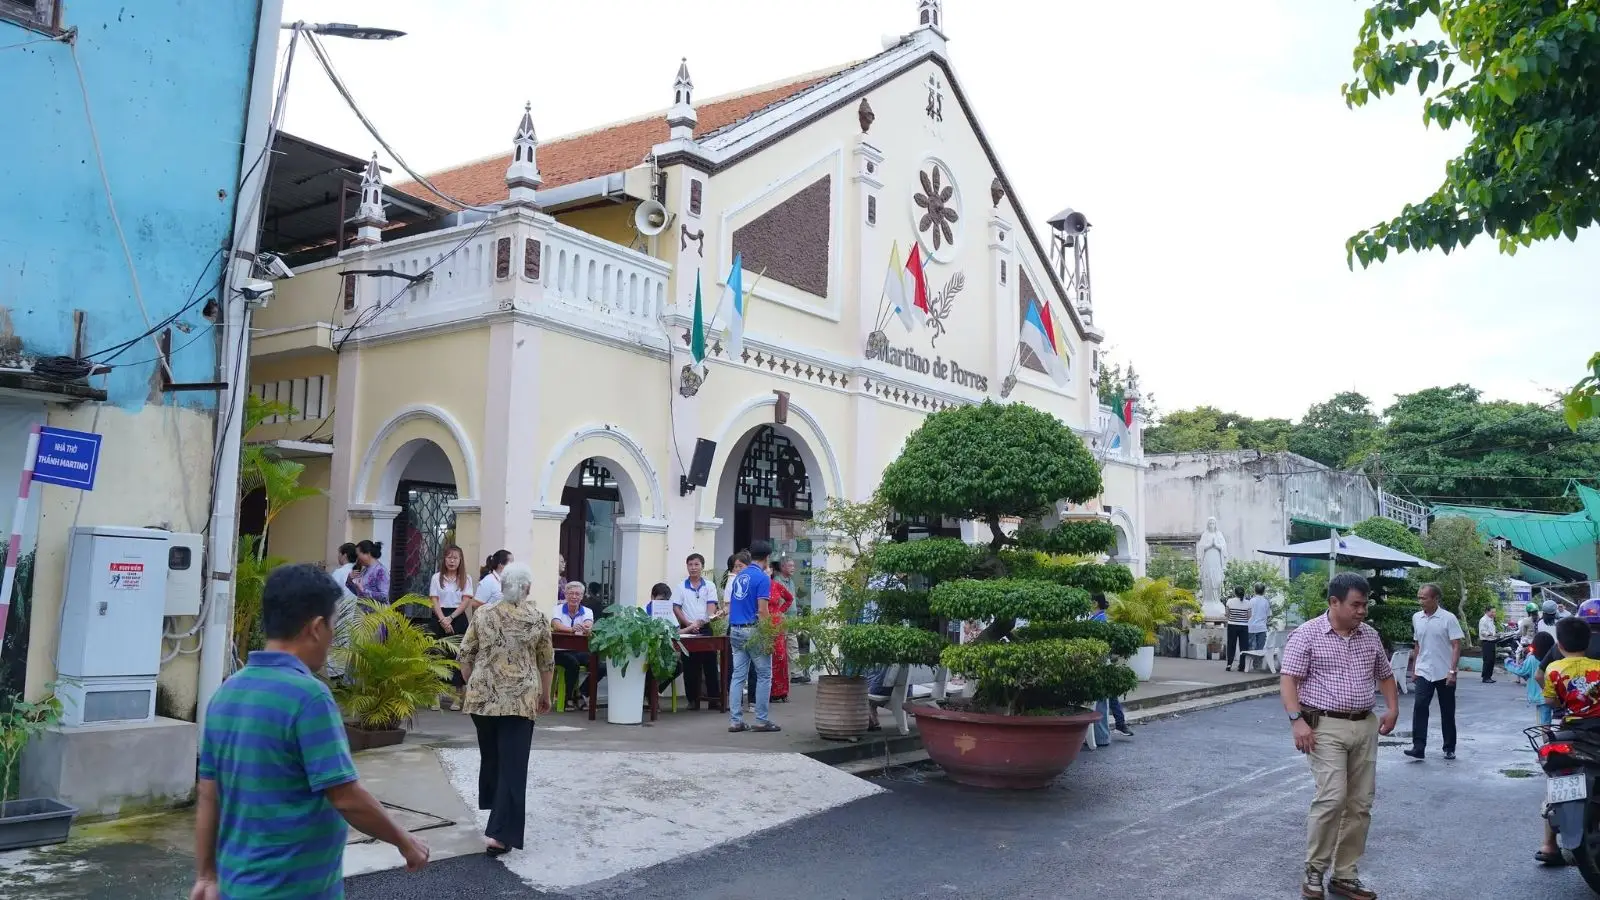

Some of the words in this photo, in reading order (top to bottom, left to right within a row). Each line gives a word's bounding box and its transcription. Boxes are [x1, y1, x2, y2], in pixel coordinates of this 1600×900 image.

[877, 340, 930, 375] Martino
[933, 355, 948, 380] de
[950, 360, 988, 392] Porres
[54, 442, 66, 452] NHÀ
[38, 454, 60, 466] THÁNH
[60, 459, 89, 471] MARTINO
